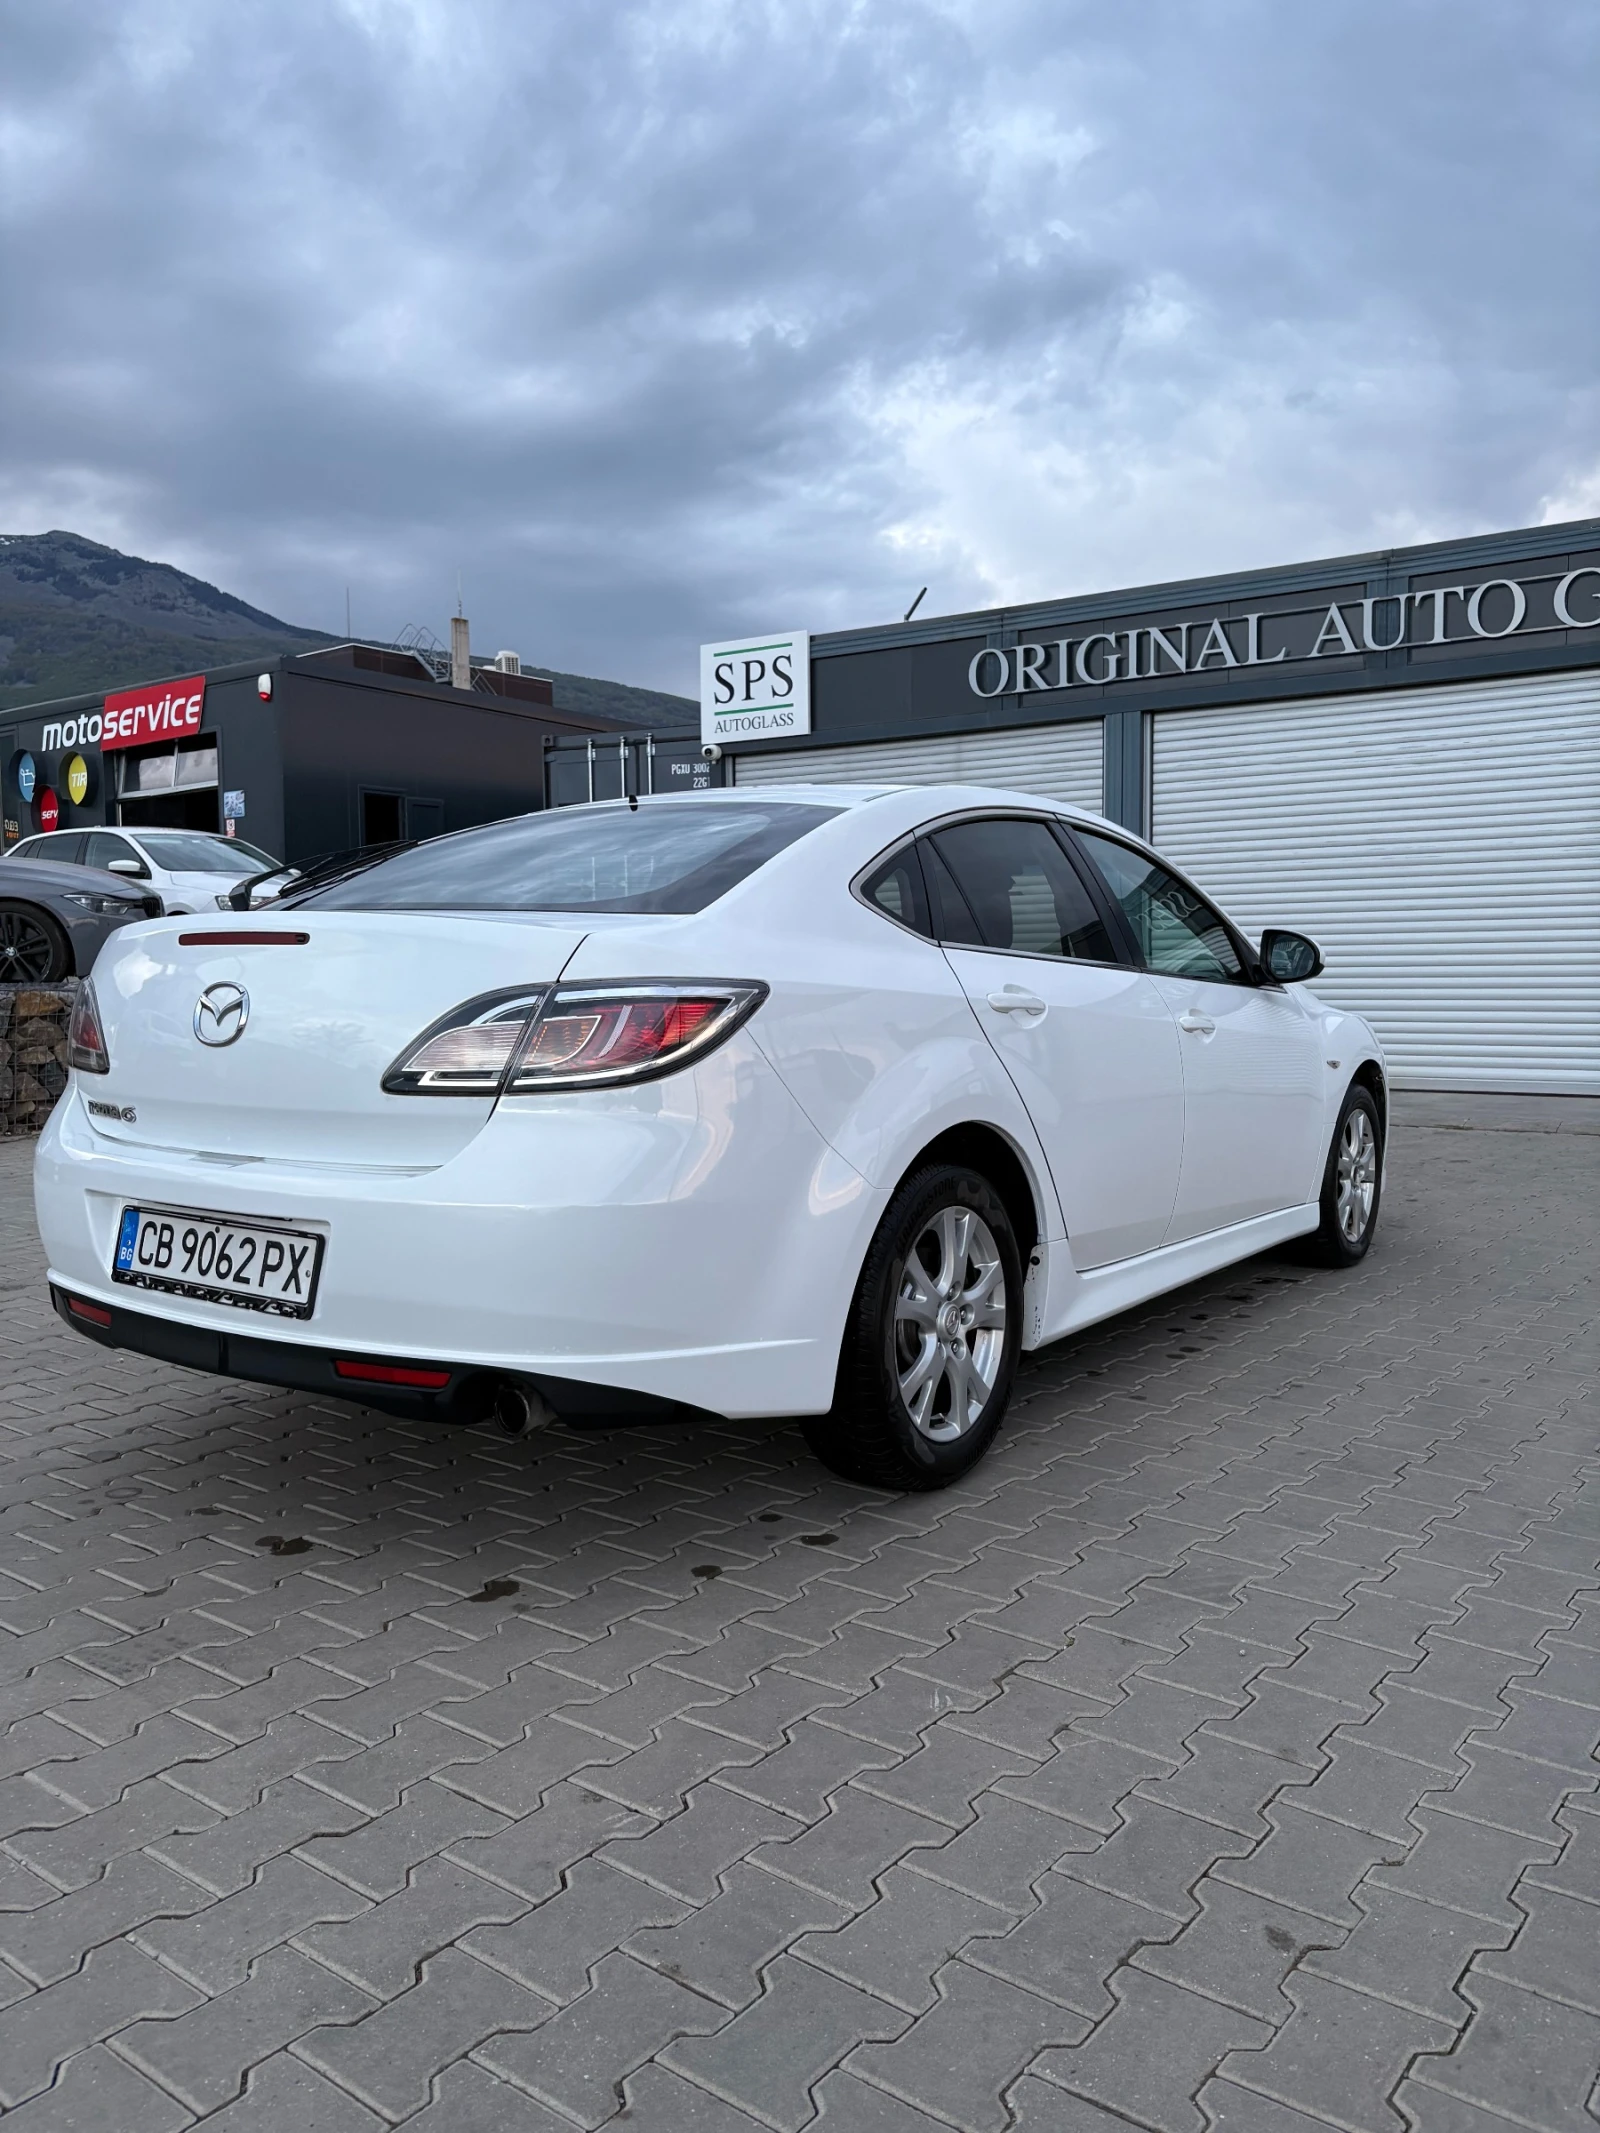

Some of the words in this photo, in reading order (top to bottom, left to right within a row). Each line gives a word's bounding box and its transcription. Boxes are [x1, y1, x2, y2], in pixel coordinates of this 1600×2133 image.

[968, 613, 1286, 698] ORIGINAL
[1308, 579, 1525, 658] AUTO
[714, 654, 794, 705] SPS
[714, 712, 794, 734] AUTOGLASS
[671, 763, 690, 775] PGXU
[120, 1246, 133, 1261] BG
